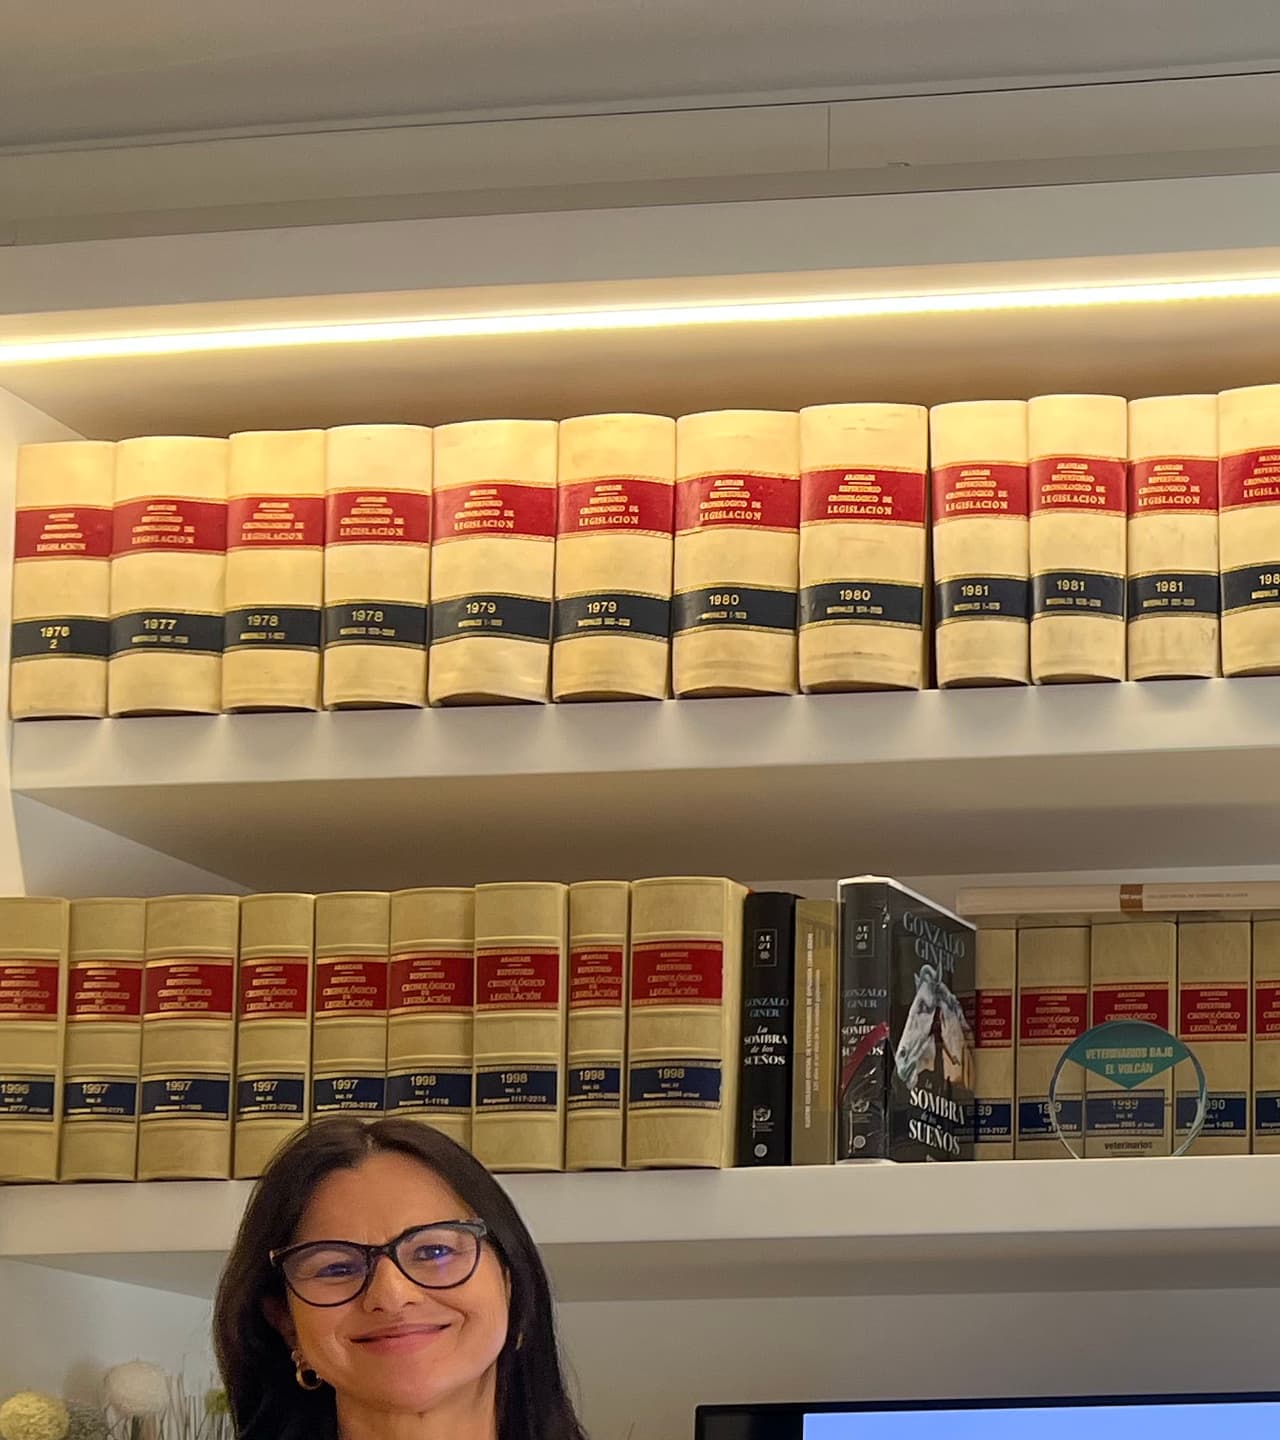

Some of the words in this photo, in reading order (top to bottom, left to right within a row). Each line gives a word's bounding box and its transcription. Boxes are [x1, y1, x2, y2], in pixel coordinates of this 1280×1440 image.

[1041, 494, 1106, 505] LEGISLACION
[1138, 495, 1200, 506] LEGISLACION
[946, 501, 1008, 511] LEGISLACION
[960, 585, 989, 597] 1981
[1056, 580, 1085, 592] 1981
[1155, 580, 1183, 593] 1981
[709, 594, 739, 605] 1980
[839, 589, 871, 601] 1980
[466, 602, 496, 614] 1979
[587, 601, 617, 614] 1979
[247, 615, 279, 626] 1978
[351, 610, 384, 622] 1978
[143, 618, 177, 630] 1977
[744, 1034, 788, 1045] SOMBRA
[500, 1073, 528, 1084] 1998
[579, 1070, 605, 1081] 1998
[656, 1068, 685, 1080] 1998
[165, 1081, 192, 1091] 1997
[252, 1081, 278, 1092] 1997
[332, 1079, 358, 1090] 1997
[410, 1075, 436, 1087] 1998
[81, 1083, 110, 1095] 1997
[910, 1088, 965, 1125] SOMBRA
[908, 1119, 960, 1155] SUEÑOS
